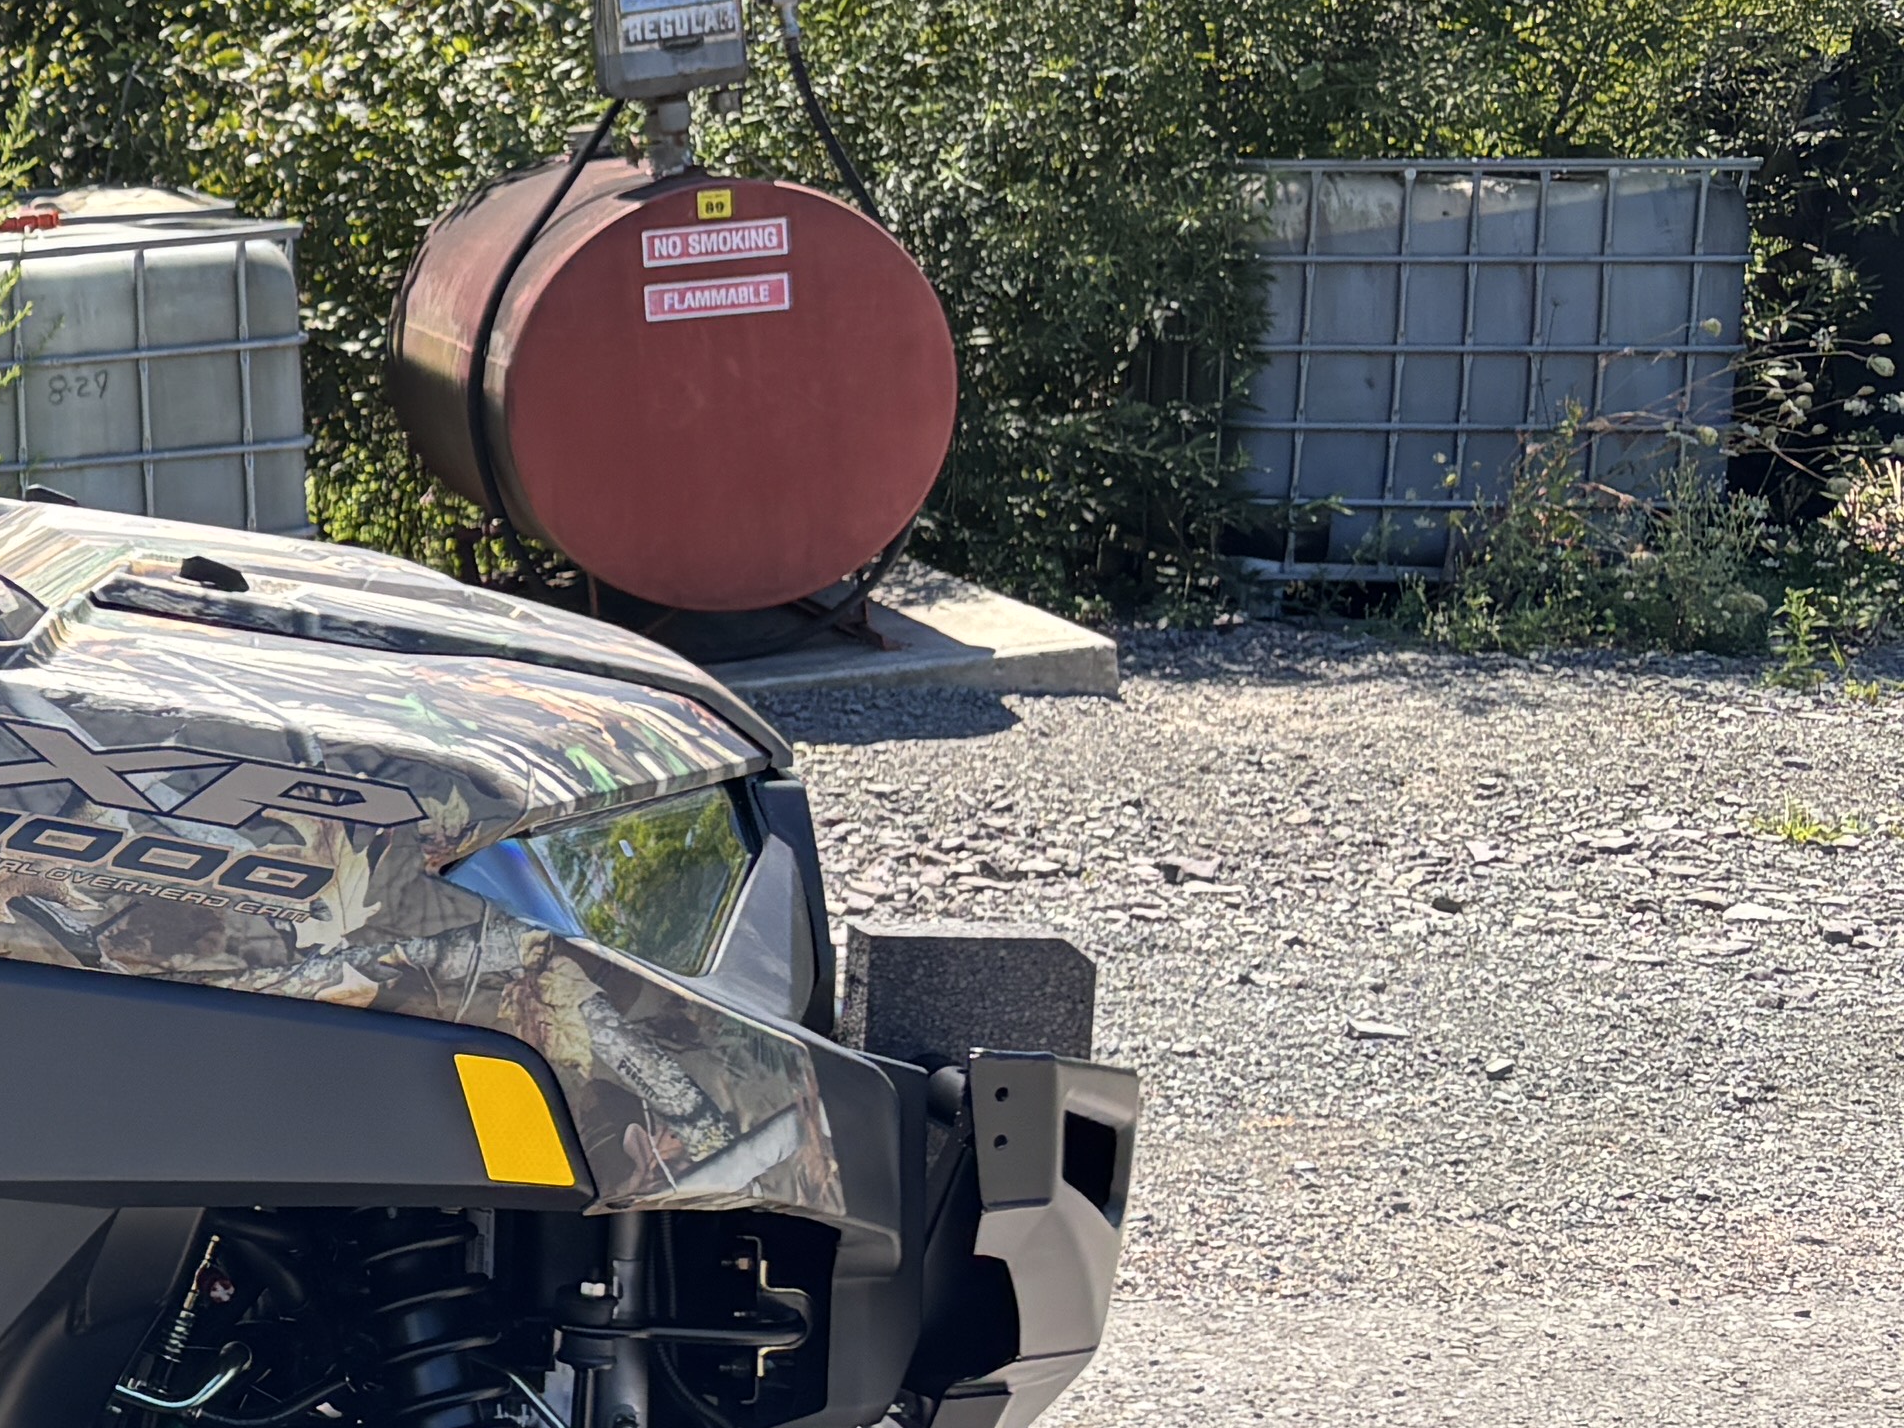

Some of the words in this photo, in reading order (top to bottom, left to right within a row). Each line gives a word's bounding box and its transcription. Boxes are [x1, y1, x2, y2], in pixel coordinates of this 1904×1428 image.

[654, 236, 681, 258] NO
[687, 226, 778, 255] SMOKING
[663, 284, 770, 311] FLAMMABLE
[45, 866, 230, 908] OVERHEAD
[234, 900, 313, 924] CAM
